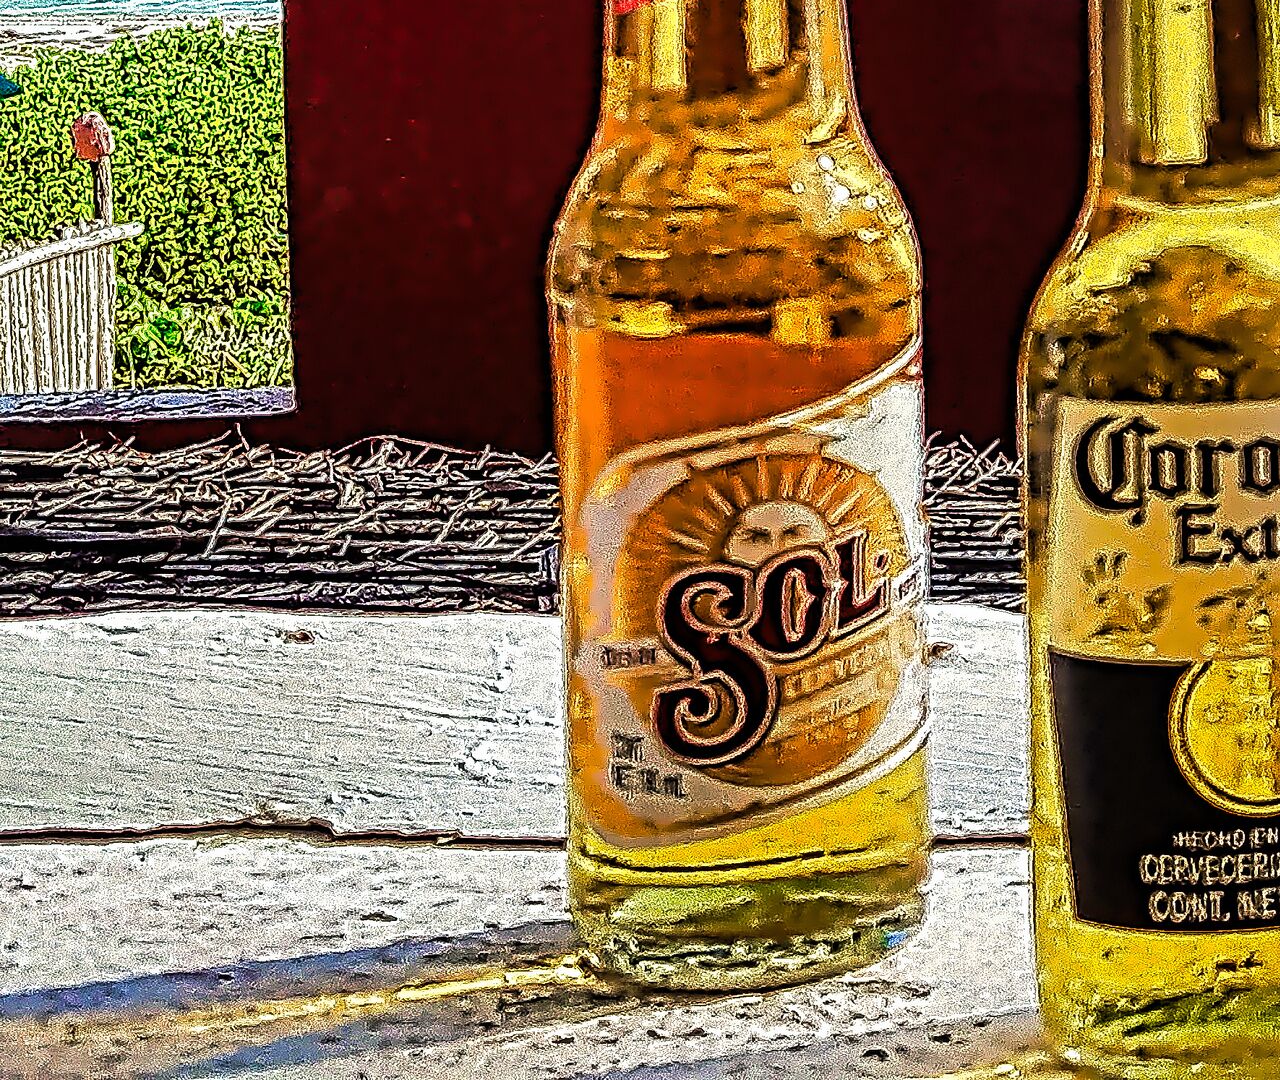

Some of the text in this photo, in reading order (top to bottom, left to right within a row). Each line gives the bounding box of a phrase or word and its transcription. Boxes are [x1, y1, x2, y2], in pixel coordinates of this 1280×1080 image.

[652, 531, 890, 767] SOL
[1173, 828, 1246, 851] HECHO
[1250, 827, 1279, 848] EN
